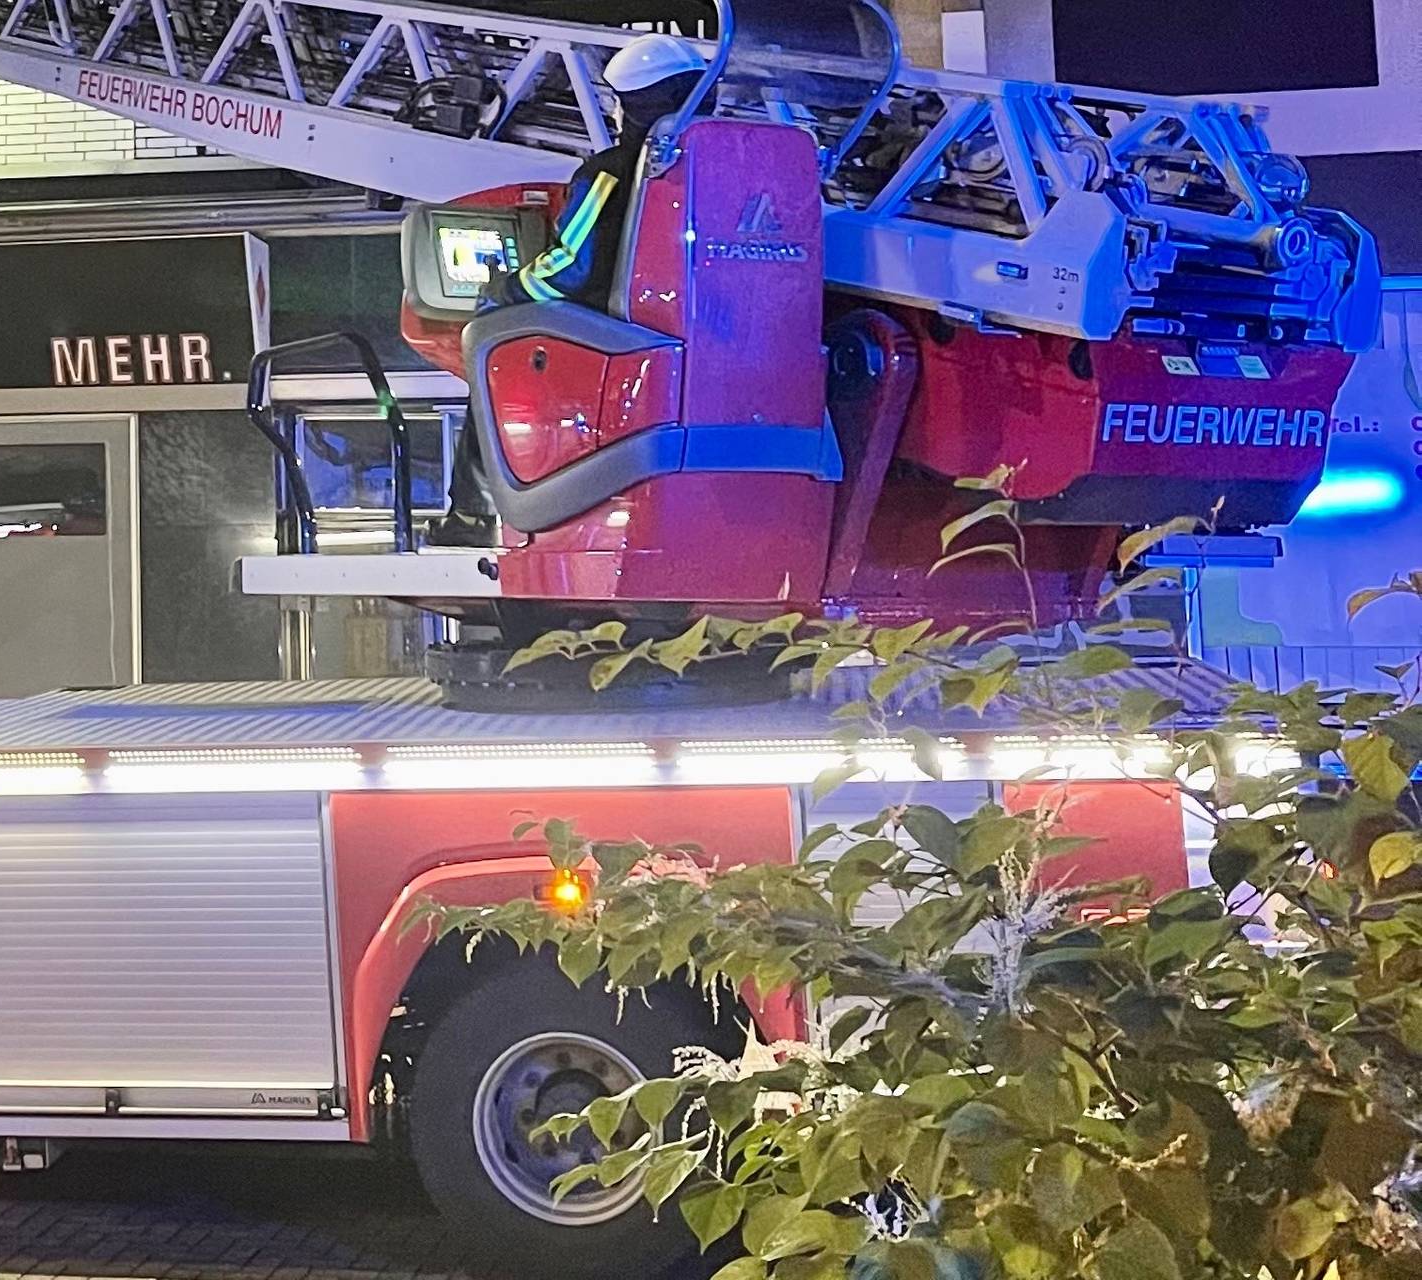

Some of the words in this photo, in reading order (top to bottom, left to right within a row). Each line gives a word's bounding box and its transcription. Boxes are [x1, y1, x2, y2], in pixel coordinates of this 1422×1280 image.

[77, 69, 187, 119] FEUERWEHR
[191, 93, 283, 139] BOCHUM
[1052, 266, 1080, 283] 32m
[49, 332, 233, 386] MEHR.
[1101, 403, 1327, 448] FEUERWEHR
